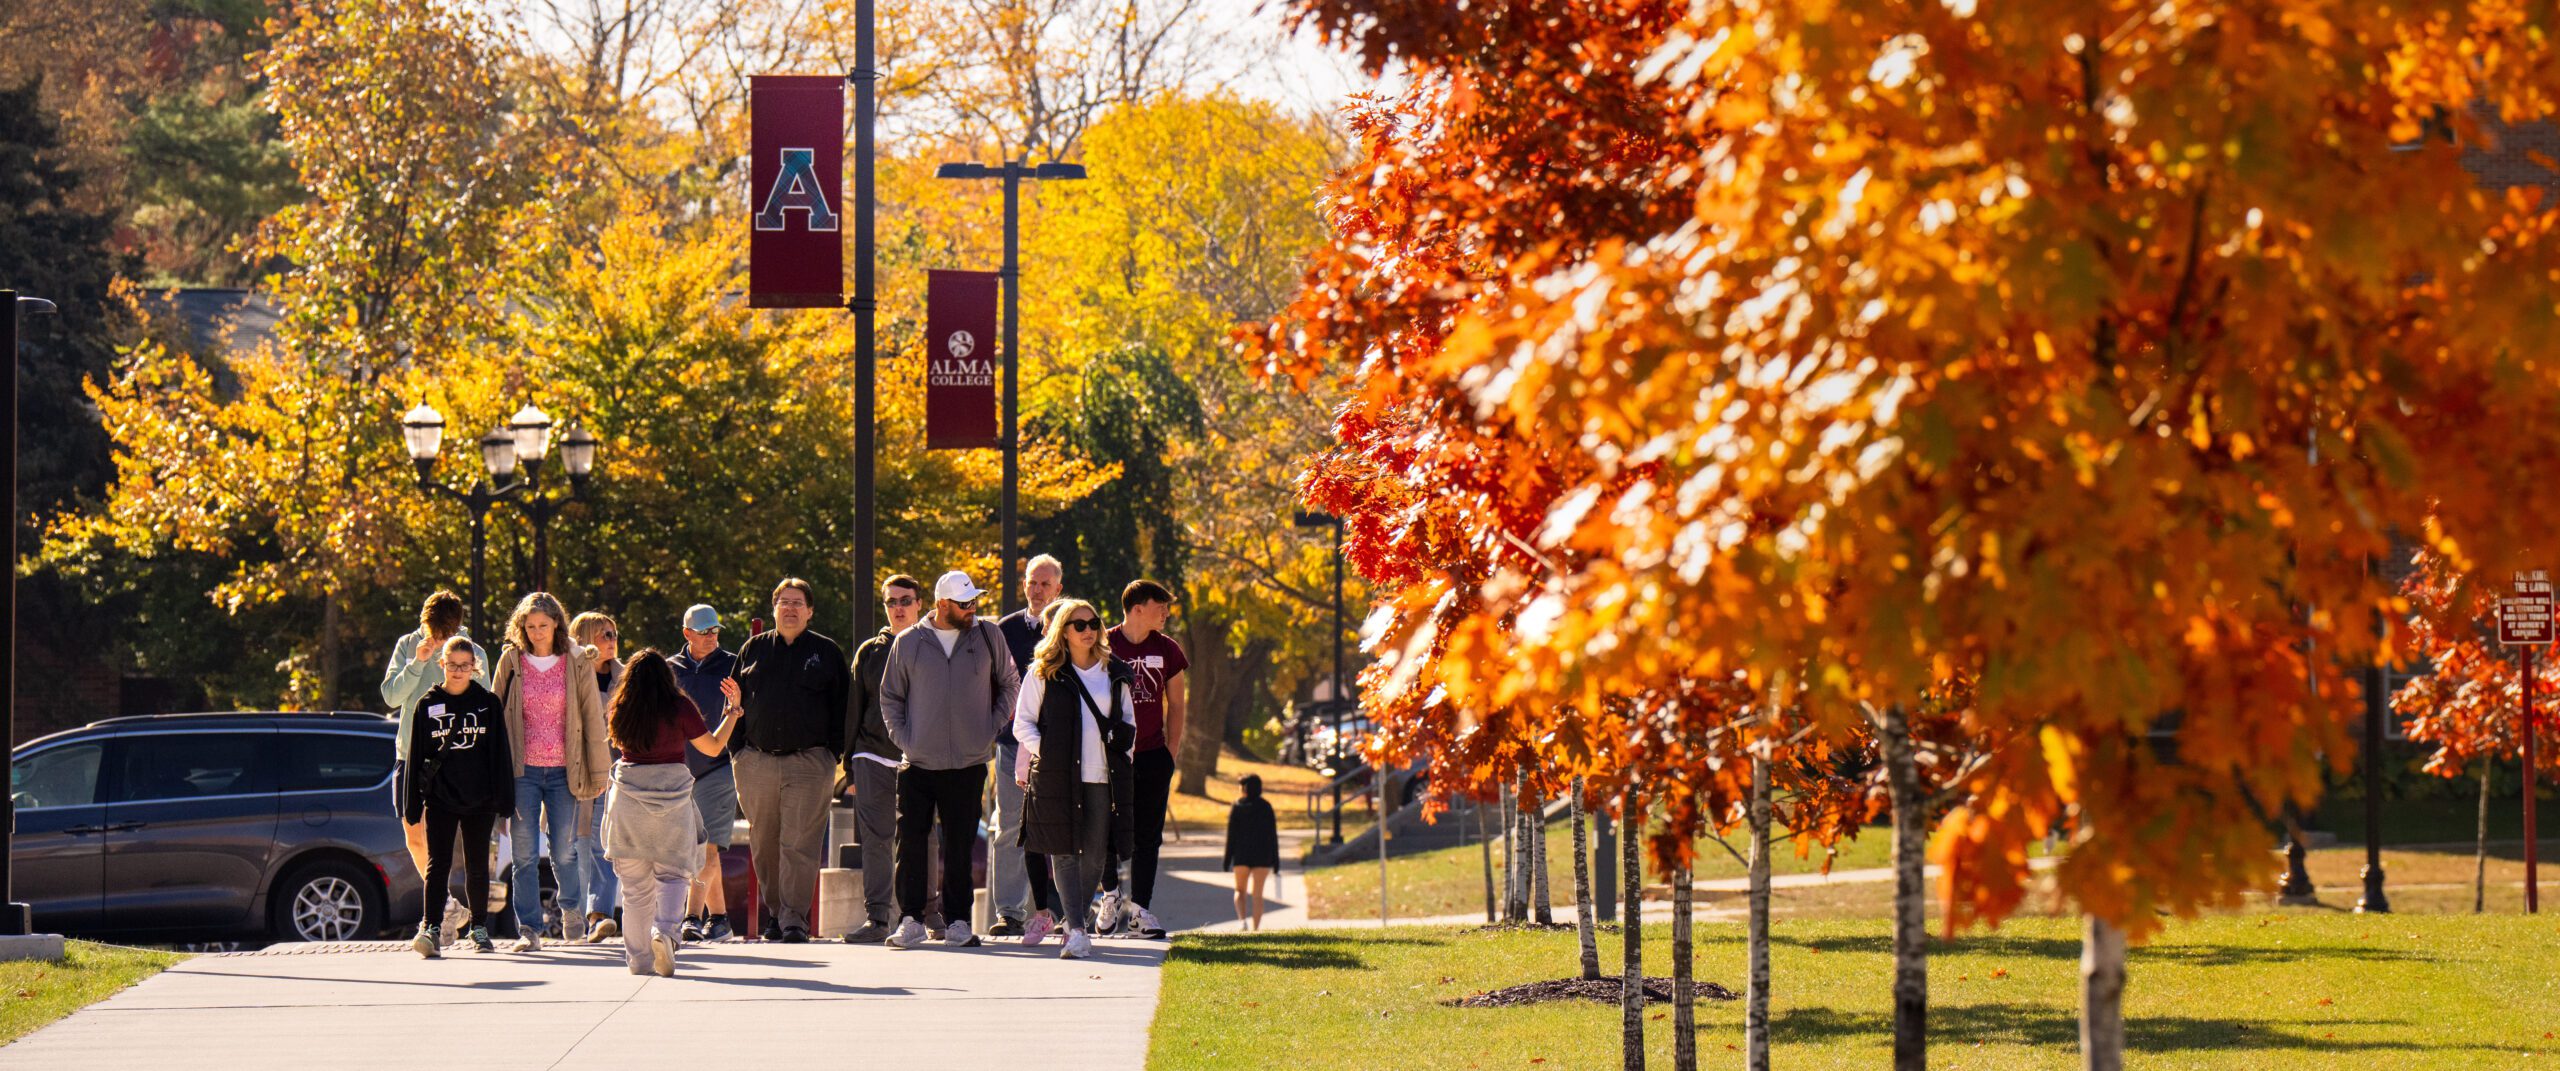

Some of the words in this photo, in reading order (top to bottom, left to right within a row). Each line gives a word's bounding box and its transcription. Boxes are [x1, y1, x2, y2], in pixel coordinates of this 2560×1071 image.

[756, 148, 838, 231] A
[930, 359, 993, 375] ALMA
[931, 374, 993, 386] COLLEGE
[2514, 582, 2527, 592] THE
[2529, 582, 2550, 592] LAWN
[462, 726, 486, 734] DIVE
